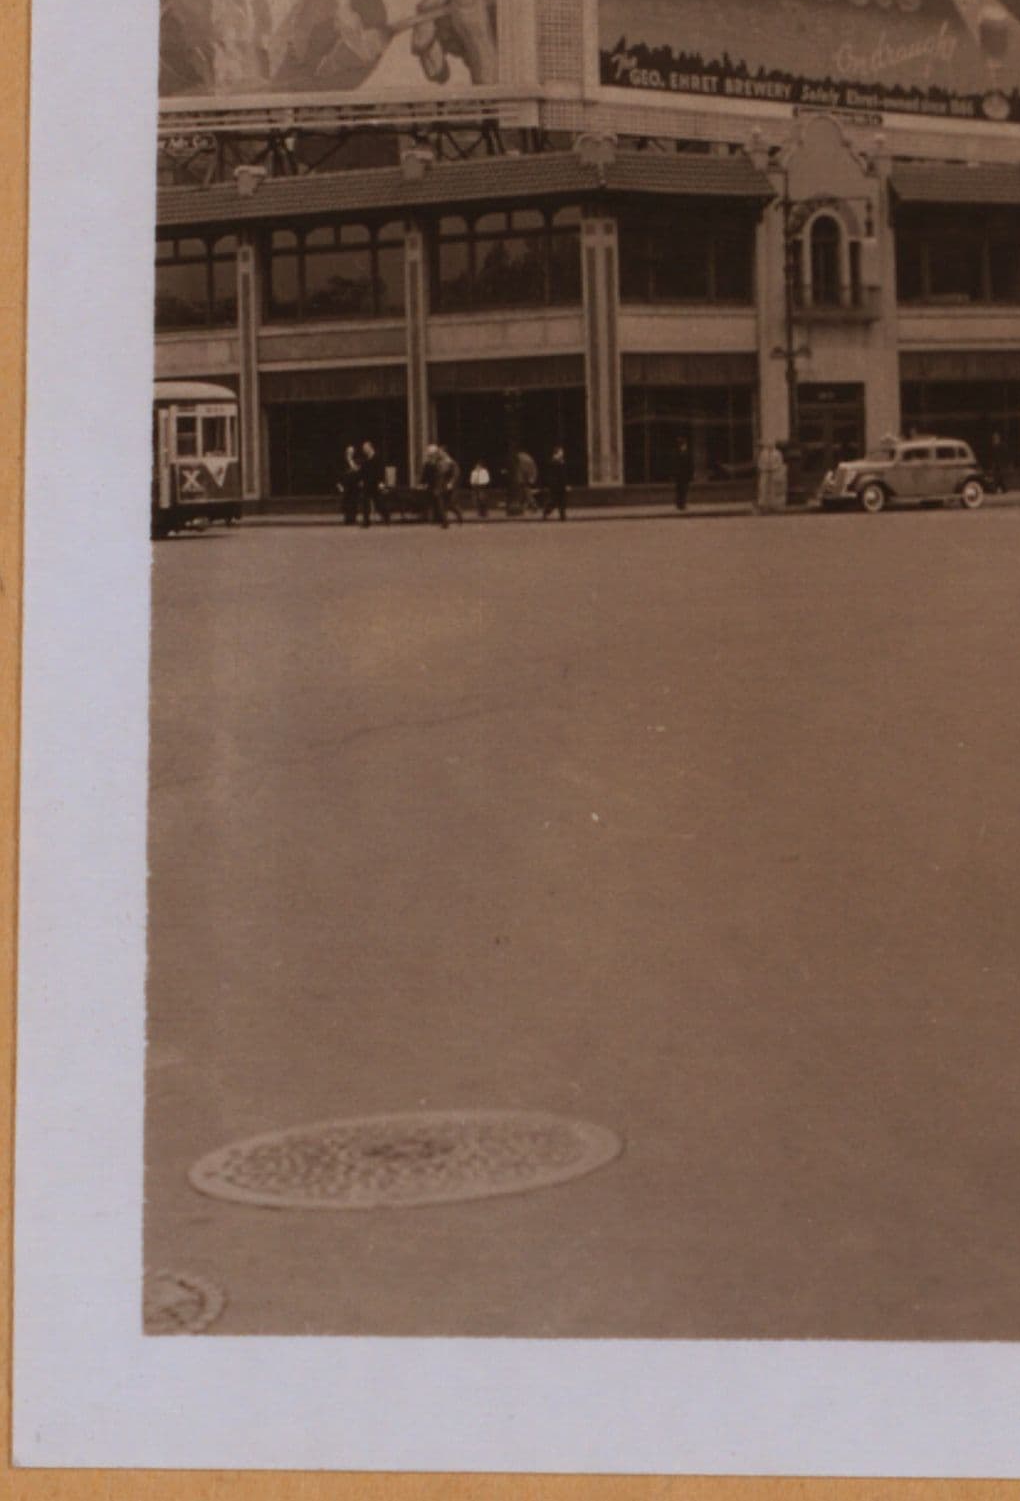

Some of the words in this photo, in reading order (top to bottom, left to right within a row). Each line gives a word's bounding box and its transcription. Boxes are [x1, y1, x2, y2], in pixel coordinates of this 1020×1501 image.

[628, 68, 665, 88] GEO.
[670, 72, 718, 93] EHRET
[724, 77, 793, 99] BREWERY
